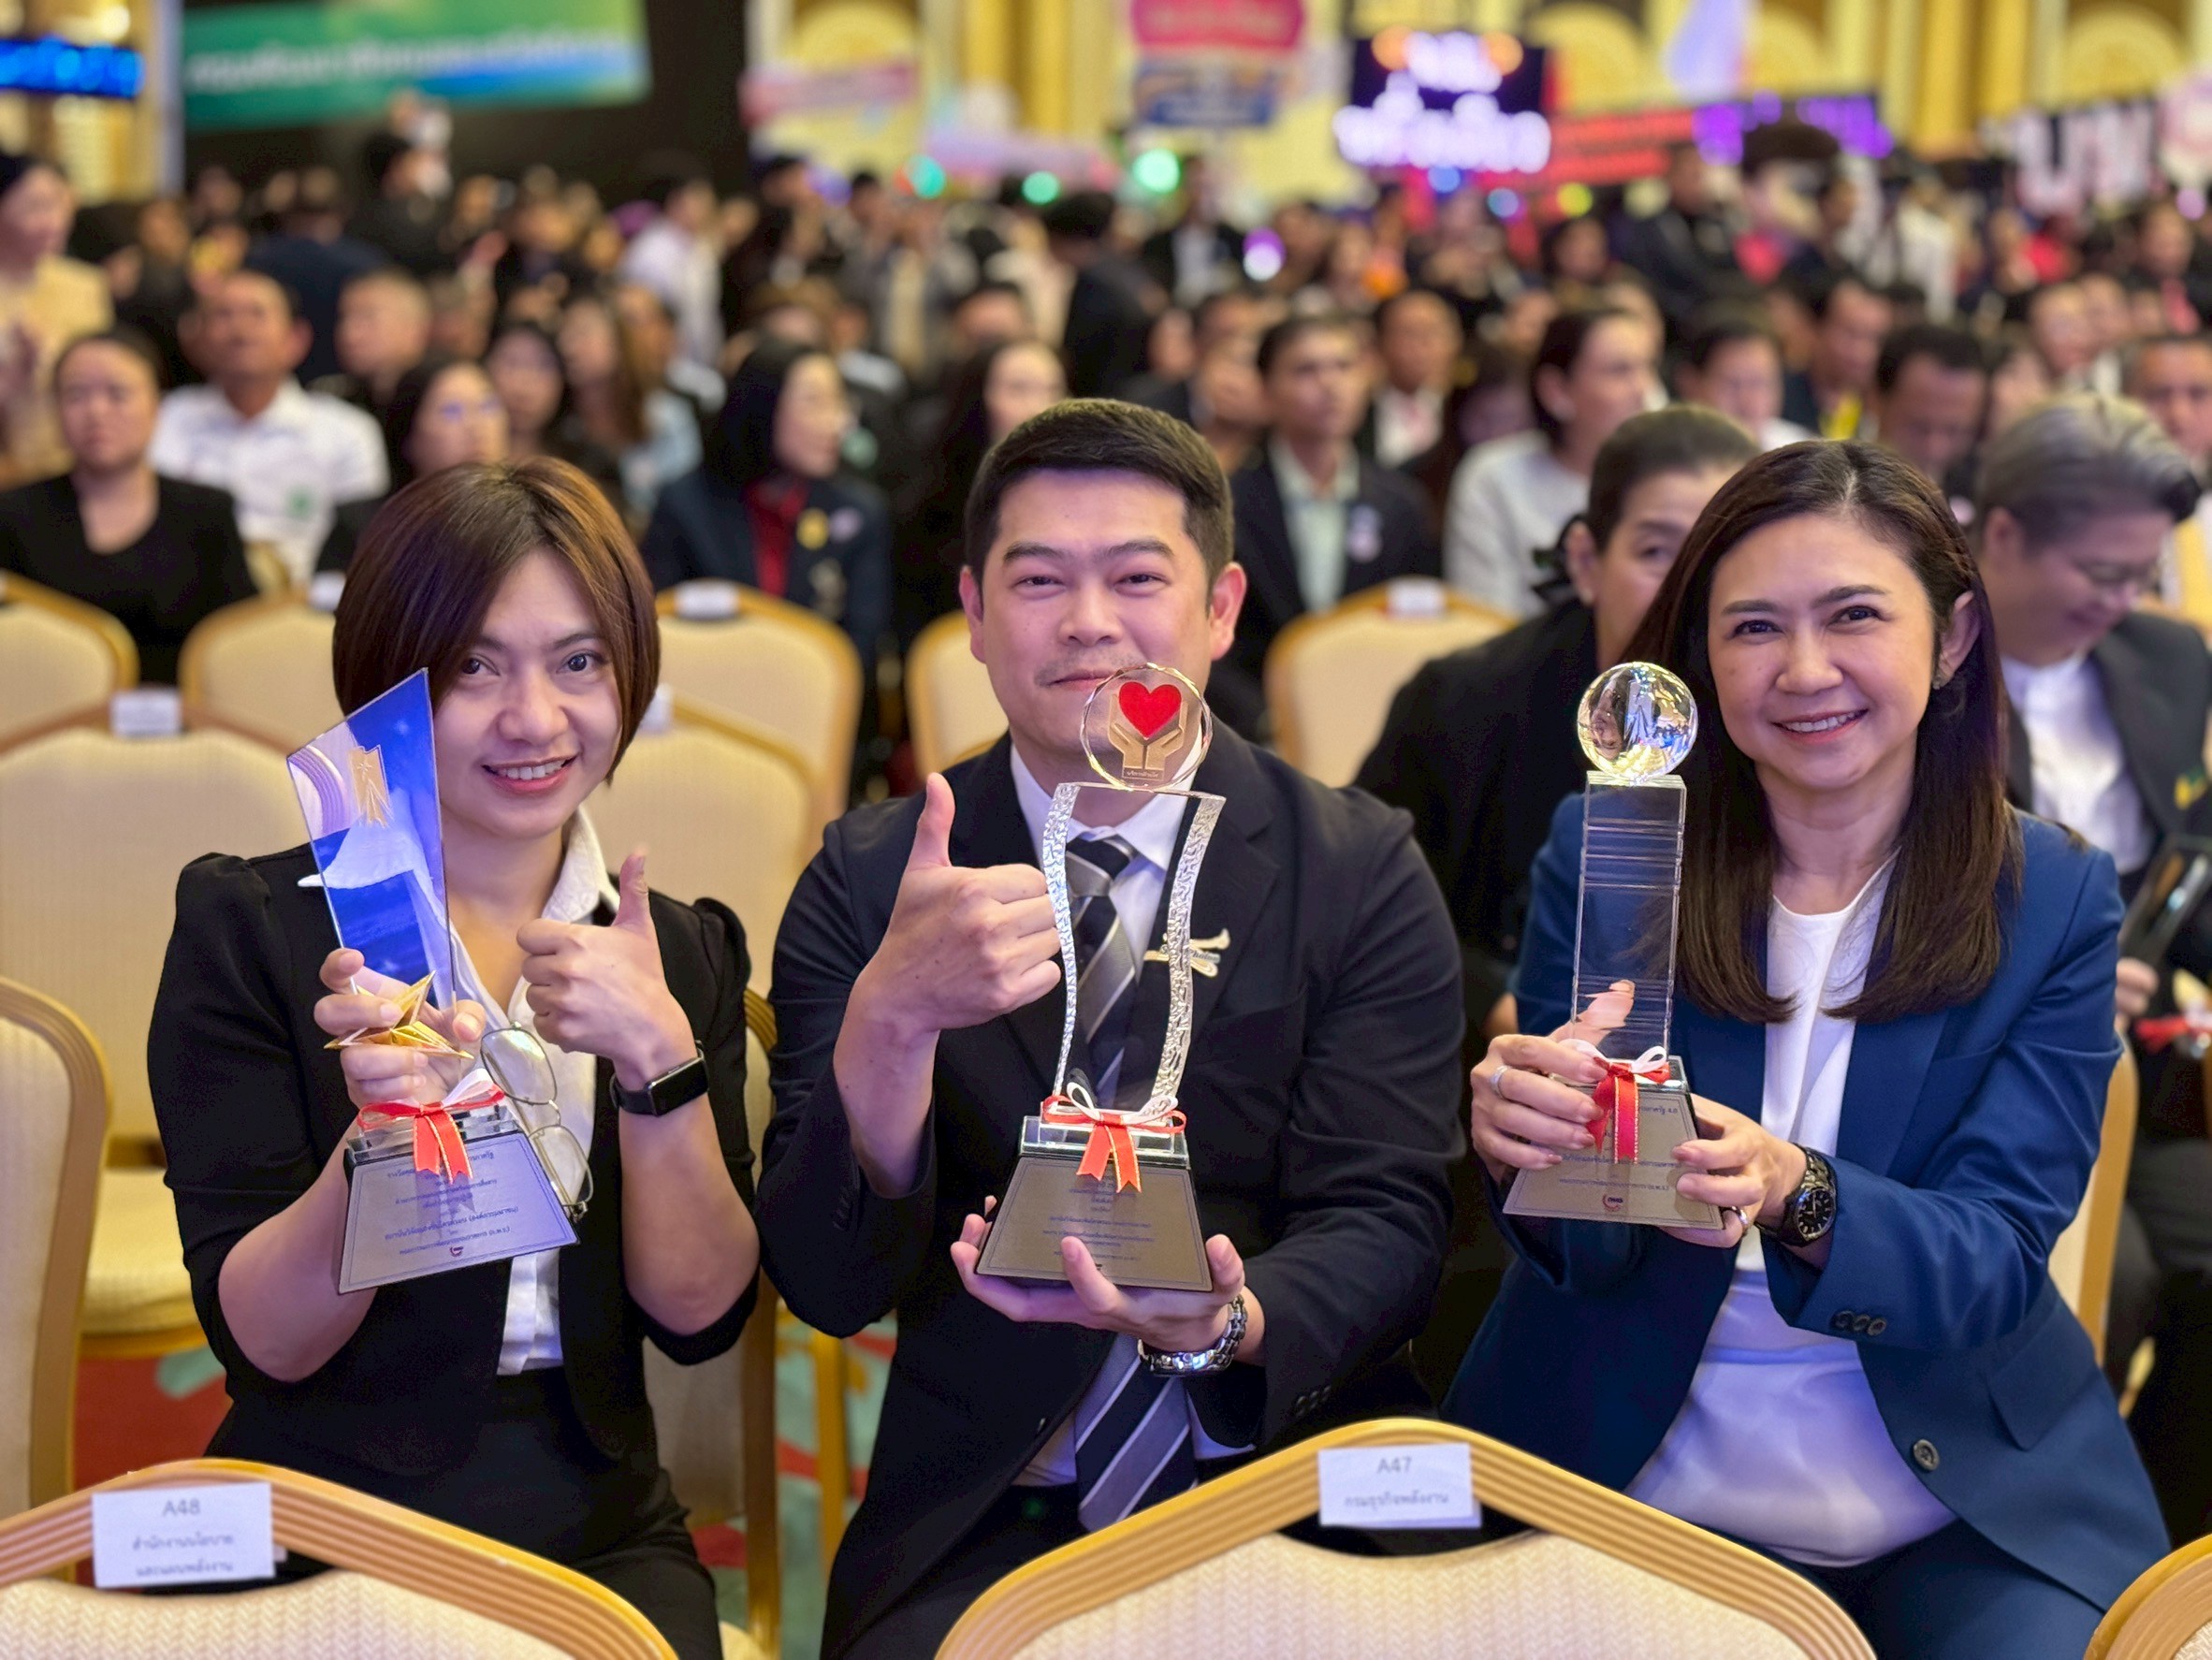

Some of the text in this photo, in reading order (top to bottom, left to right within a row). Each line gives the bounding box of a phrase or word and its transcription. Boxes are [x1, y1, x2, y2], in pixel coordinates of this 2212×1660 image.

[1376, 1456, 1412, 1474] A47
[162, 1497, 201, 1516] A48
[1344, 1489, 1449, 1512] กรมธุรกิจพลังงาน
[132, 1530, 234, 1551] สำนักงานนโยบาย
[136, 1557, 234, 1577] และแผนพลังงาน
